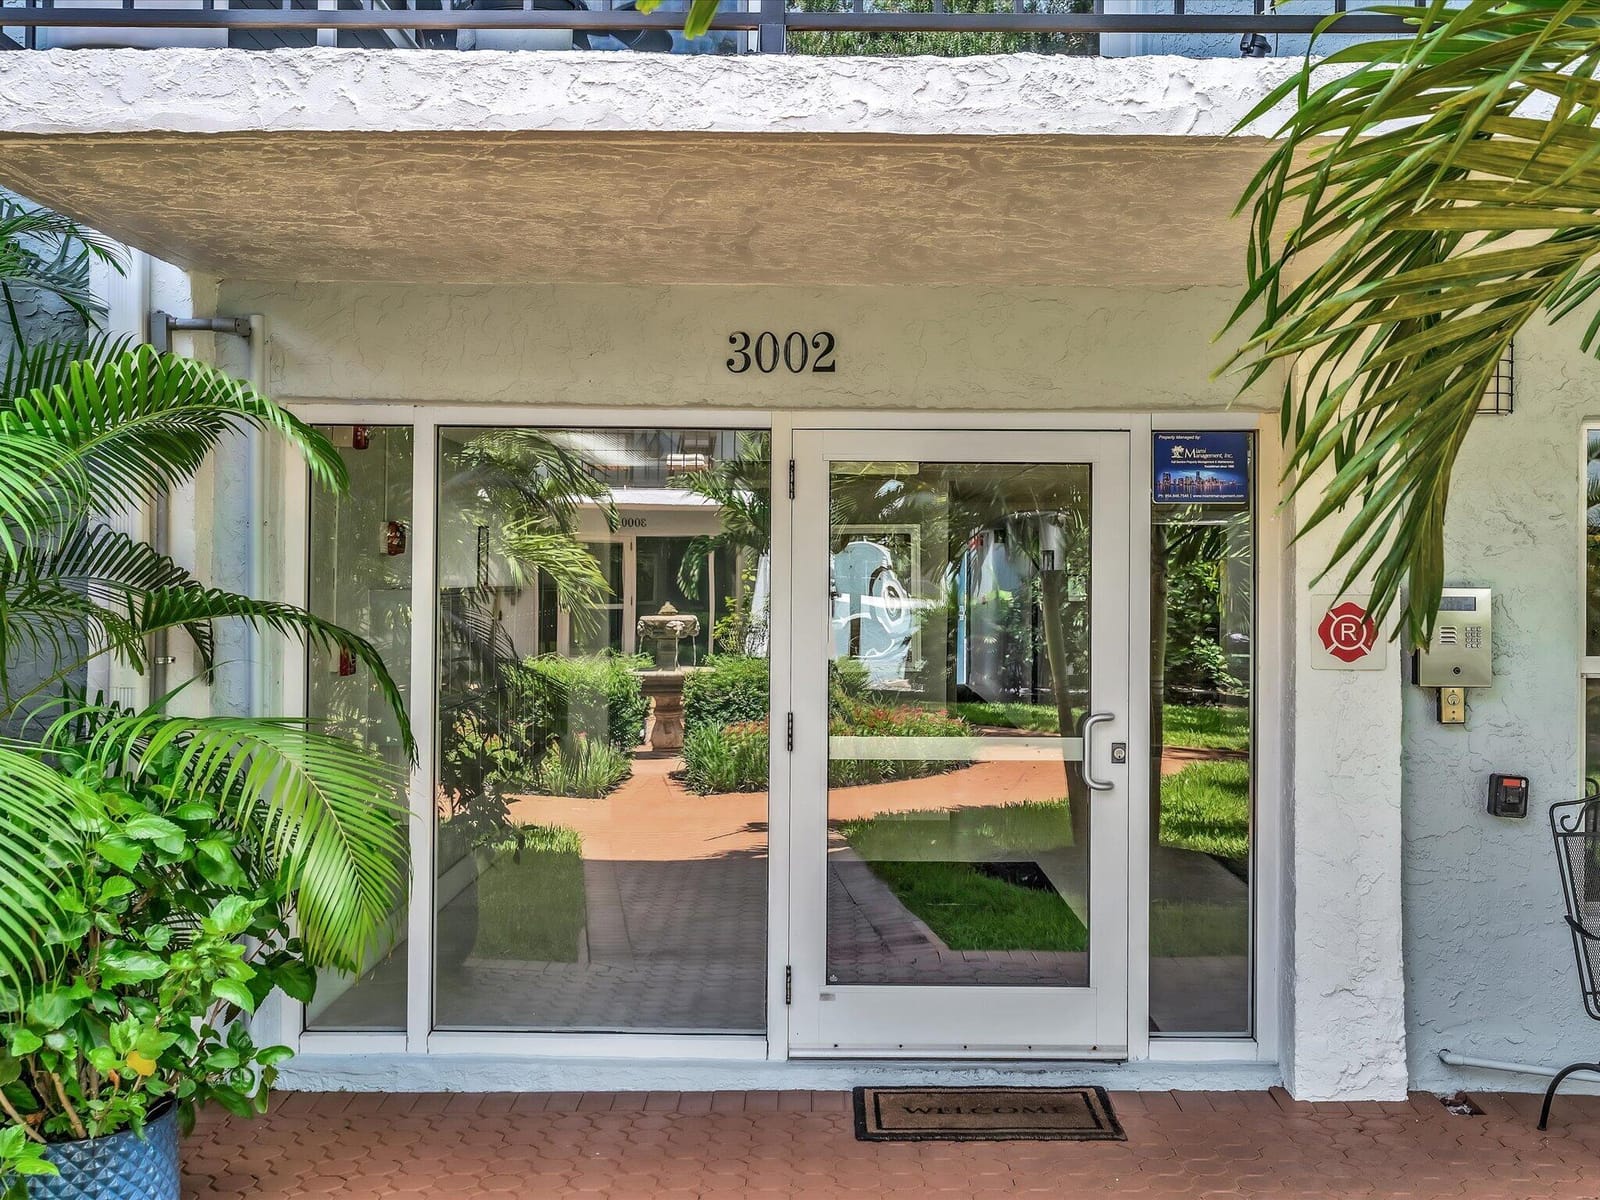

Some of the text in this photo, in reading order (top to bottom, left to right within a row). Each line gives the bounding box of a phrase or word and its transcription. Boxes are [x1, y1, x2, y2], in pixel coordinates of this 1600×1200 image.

[726, 331, 836, 374] 3002
[1341, 623, 1357, 641] R
[903, 1105, 1069, 1115] WELCOME
